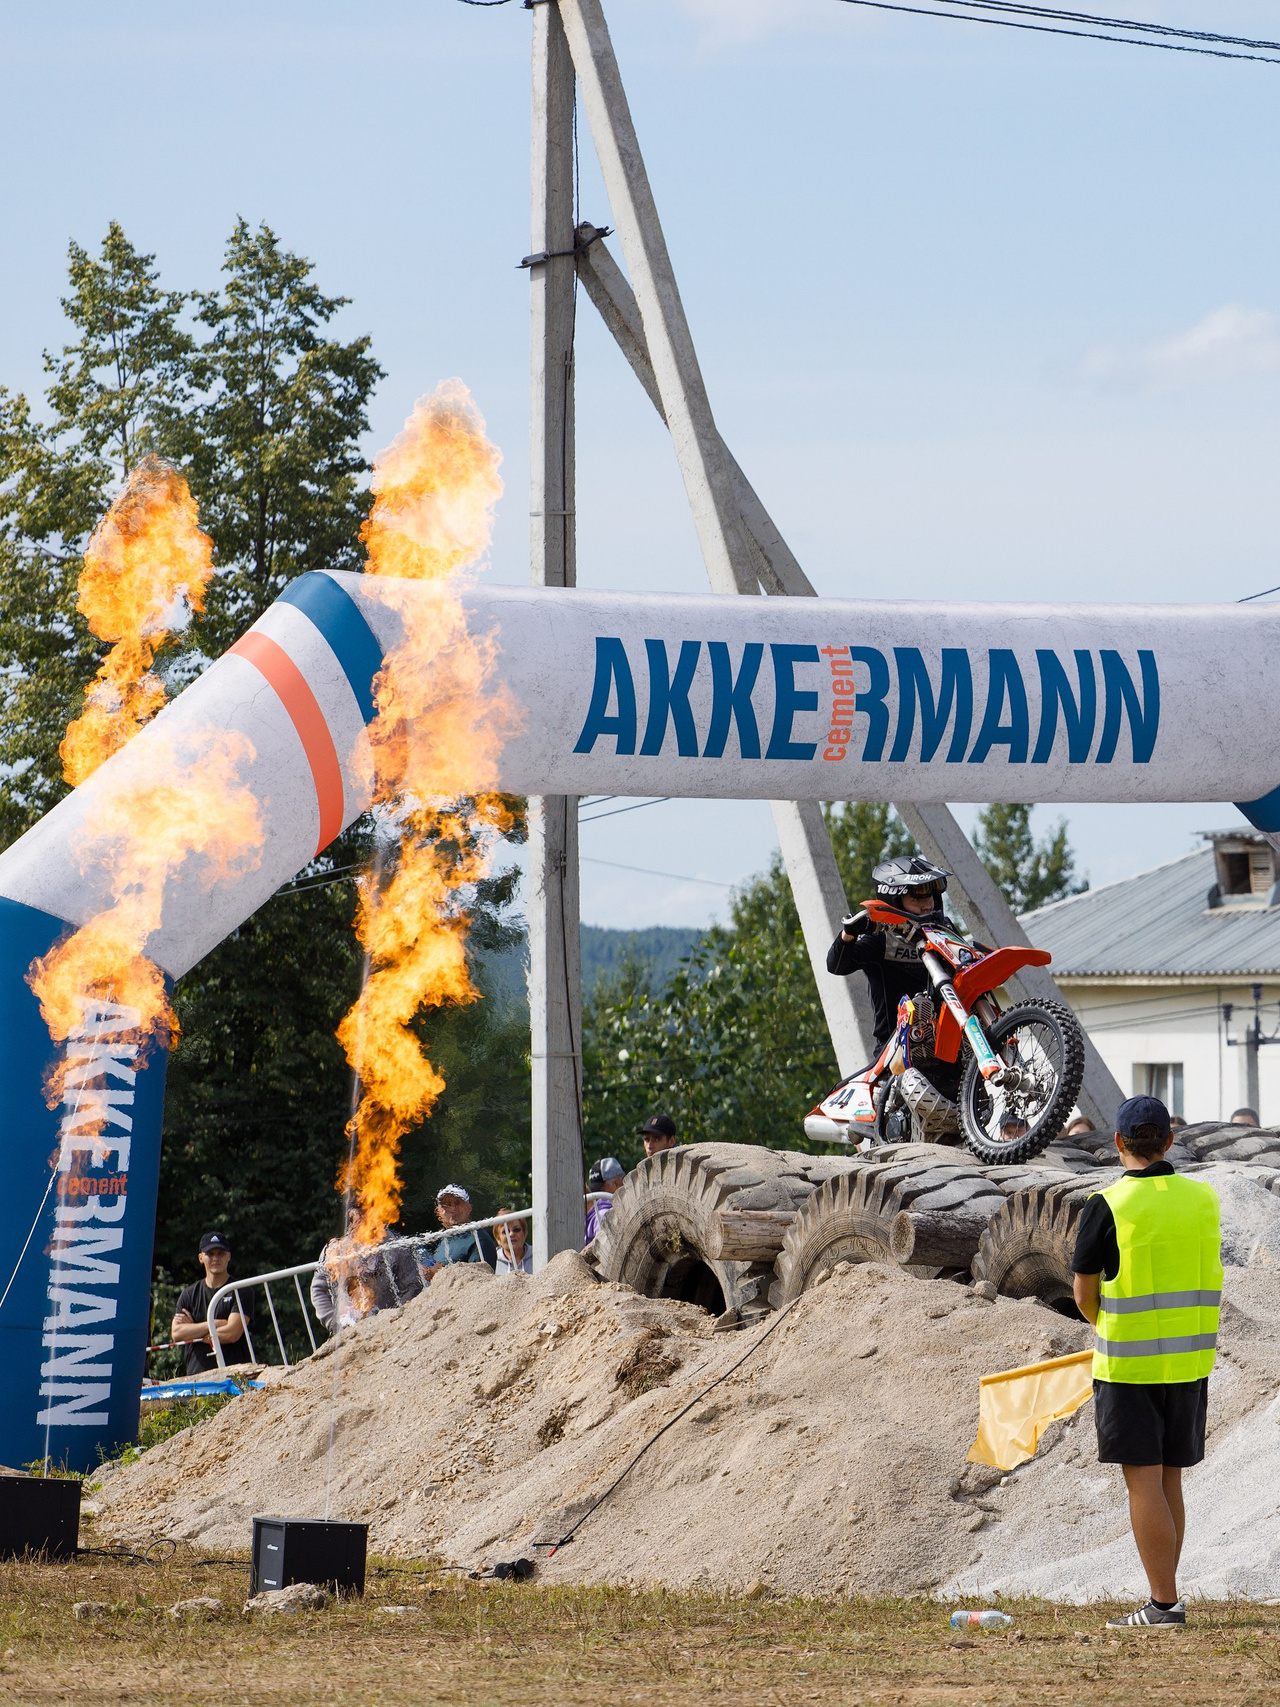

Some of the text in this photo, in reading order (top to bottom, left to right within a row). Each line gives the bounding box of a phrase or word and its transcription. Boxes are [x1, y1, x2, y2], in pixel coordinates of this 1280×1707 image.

[573, 637, 1160, 763] AKKERMANN
[821, 644, 850, 762] cement
[877, 884, 908, 895] 100%
[894, 948, 921, 960] FAS
[828, 1088, 855, 1109] 44
[57, 1171, 128, 1195] cement
[36, 997, 142, 1426] AKKERMANN
